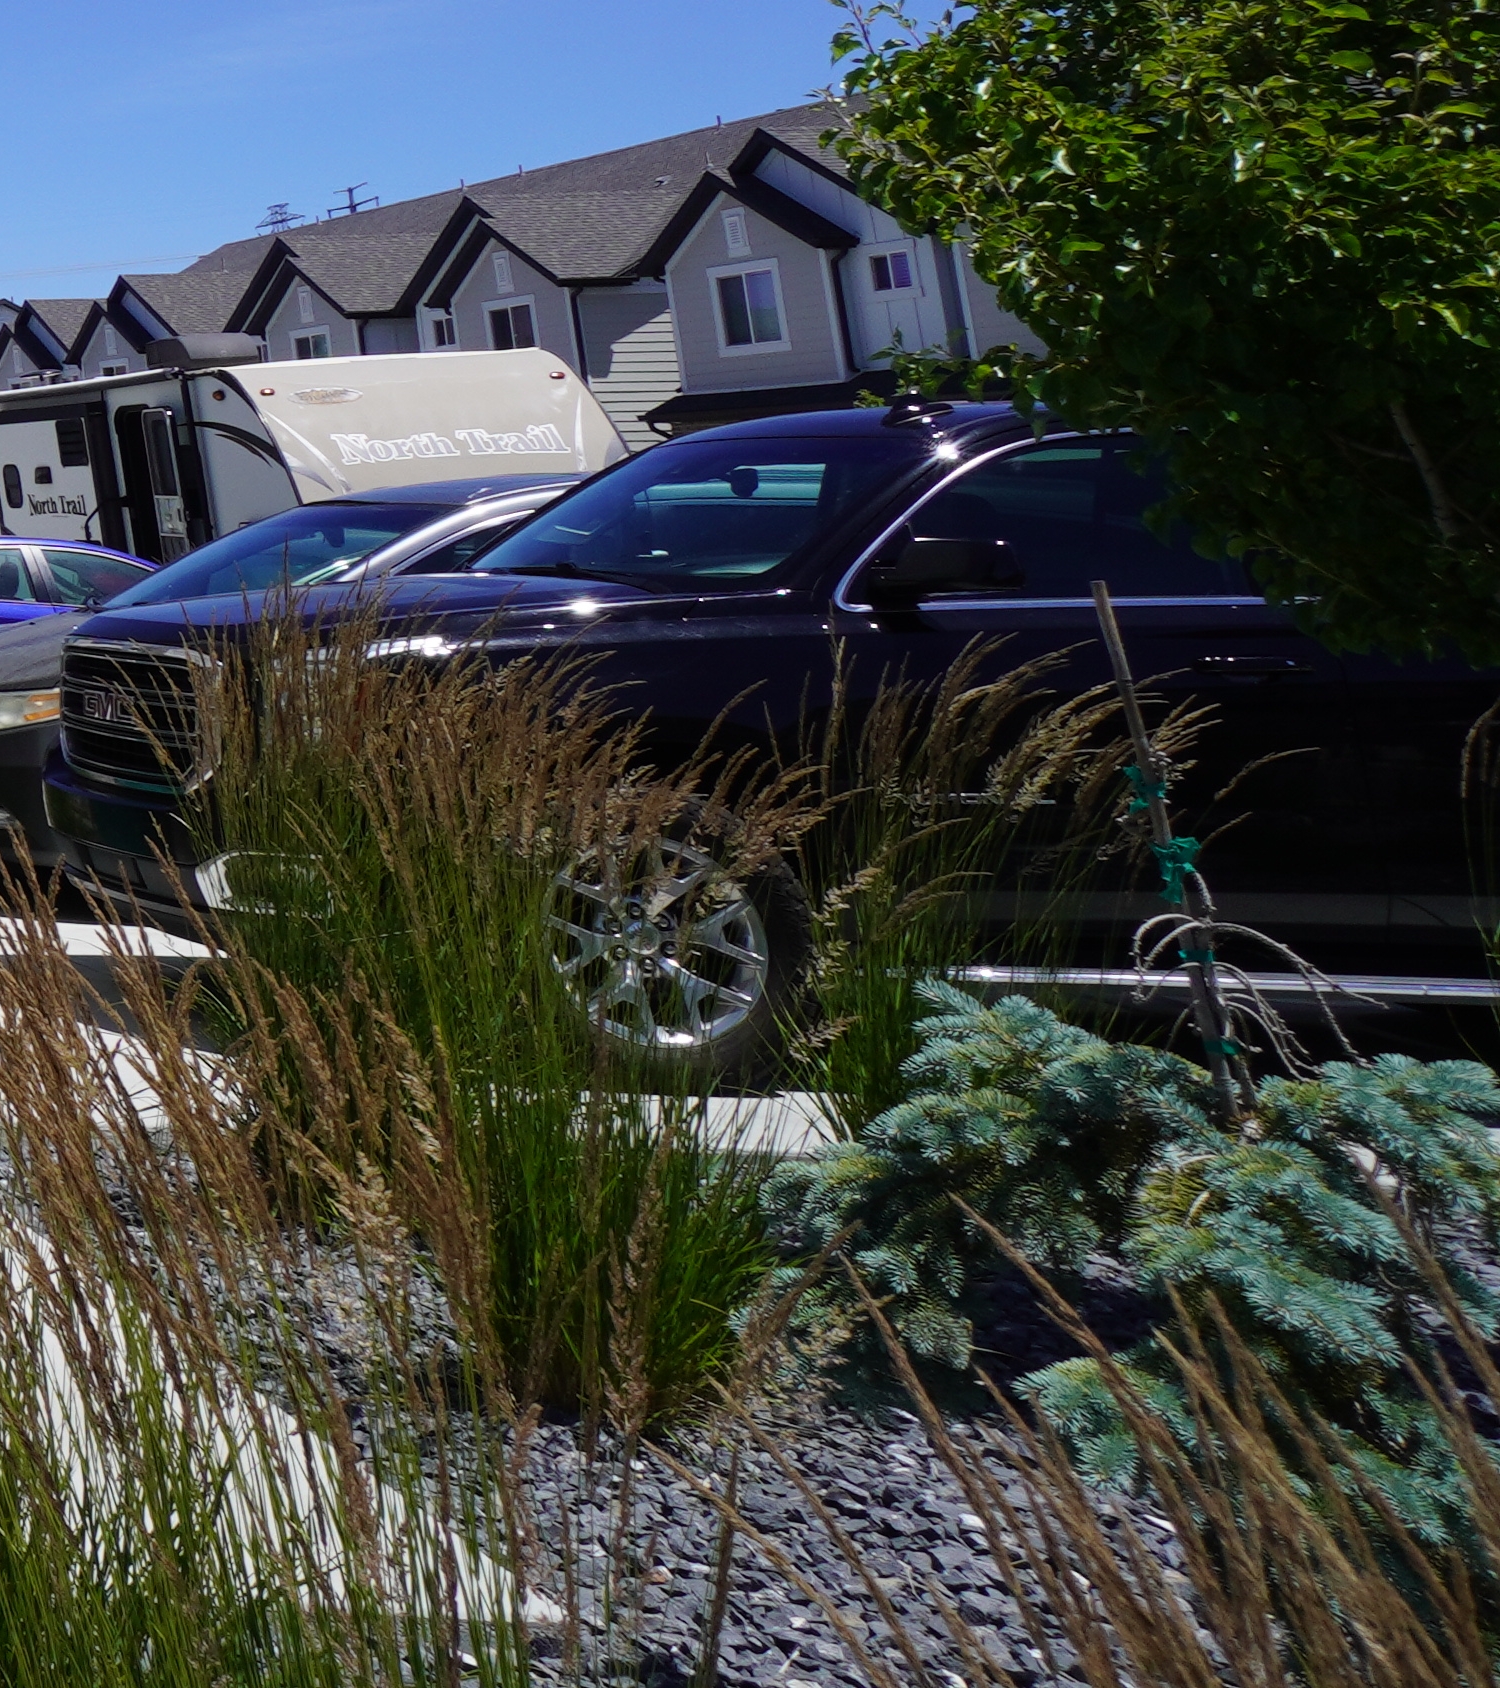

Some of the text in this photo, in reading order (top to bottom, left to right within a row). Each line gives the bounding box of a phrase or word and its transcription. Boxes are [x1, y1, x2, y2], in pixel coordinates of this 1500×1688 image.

[330, 423, 571, 465] North Trail
[27, 494, 87, 516] North Trail
[83, 689, 137, 725] GMC
